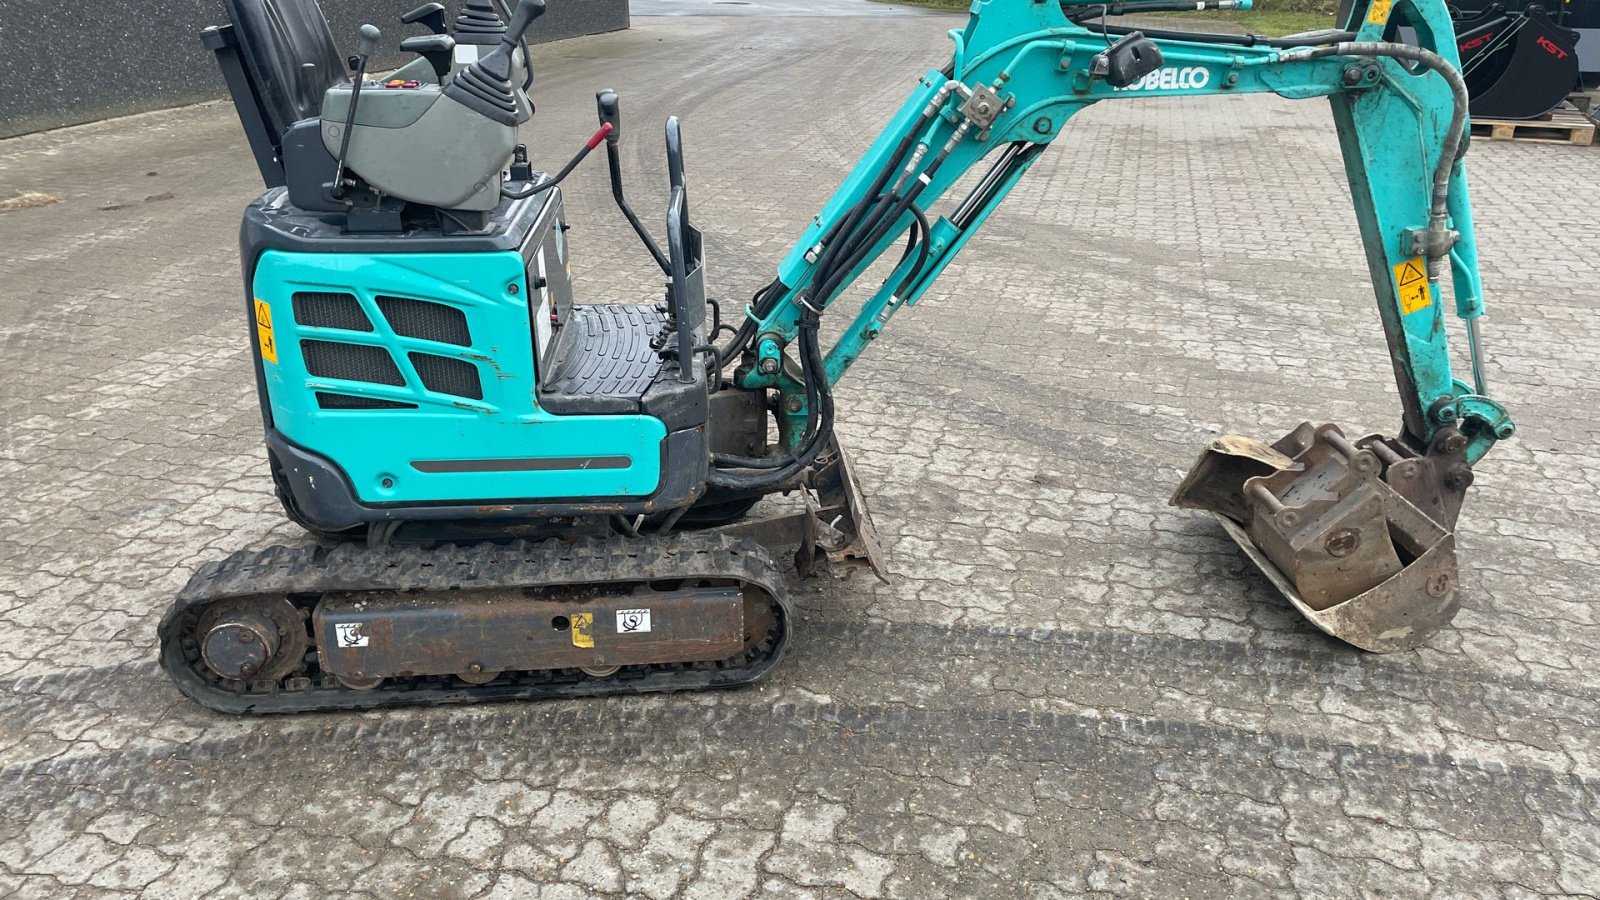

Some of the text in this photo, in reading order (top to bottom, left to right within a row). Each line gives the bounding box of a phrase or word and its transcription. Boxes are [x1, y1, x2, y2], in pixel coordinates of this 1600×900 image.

[1459, 32, 1493, 52] KST
[1536, 35, 1569, 60] KST
[1113, 66, 1210, 91] OBELCO
